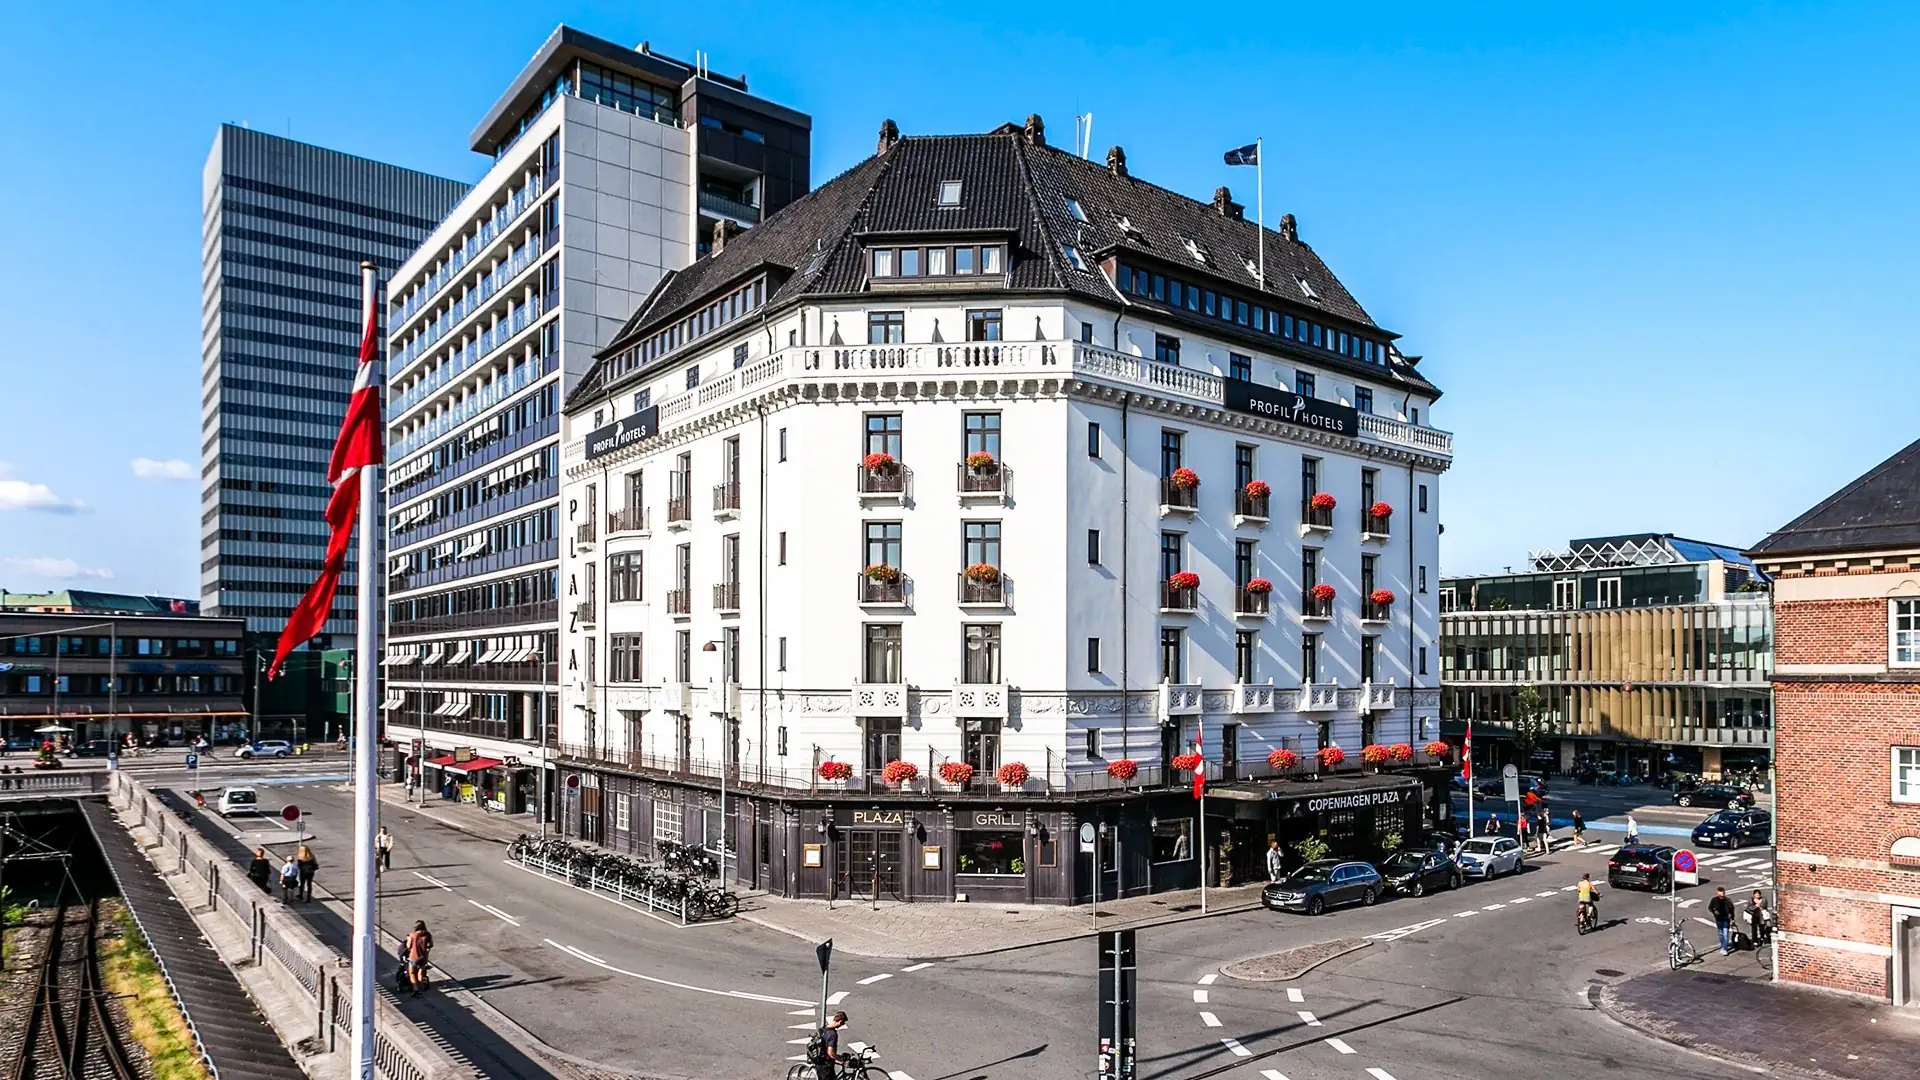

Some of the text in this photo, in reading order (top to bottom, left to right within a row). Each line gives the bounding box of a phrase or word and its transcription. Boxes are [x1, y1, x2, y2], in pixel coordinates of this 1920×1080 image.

[1250, 398, 1290, 419] PROFIL
[1302, 412, 1343, 431] HOTELS
[593, 438, 615, 454] PROFIL
[620, 424, 646, 443] HOTELS
[569, 498, 578, 671] PLAZA
[652, 787, 672, 800] PLAZA
[1308, 791, 1399, 811] COPENHAGEN PLAZA
[854, 812, 1021, 826] PLAZA GRILL
